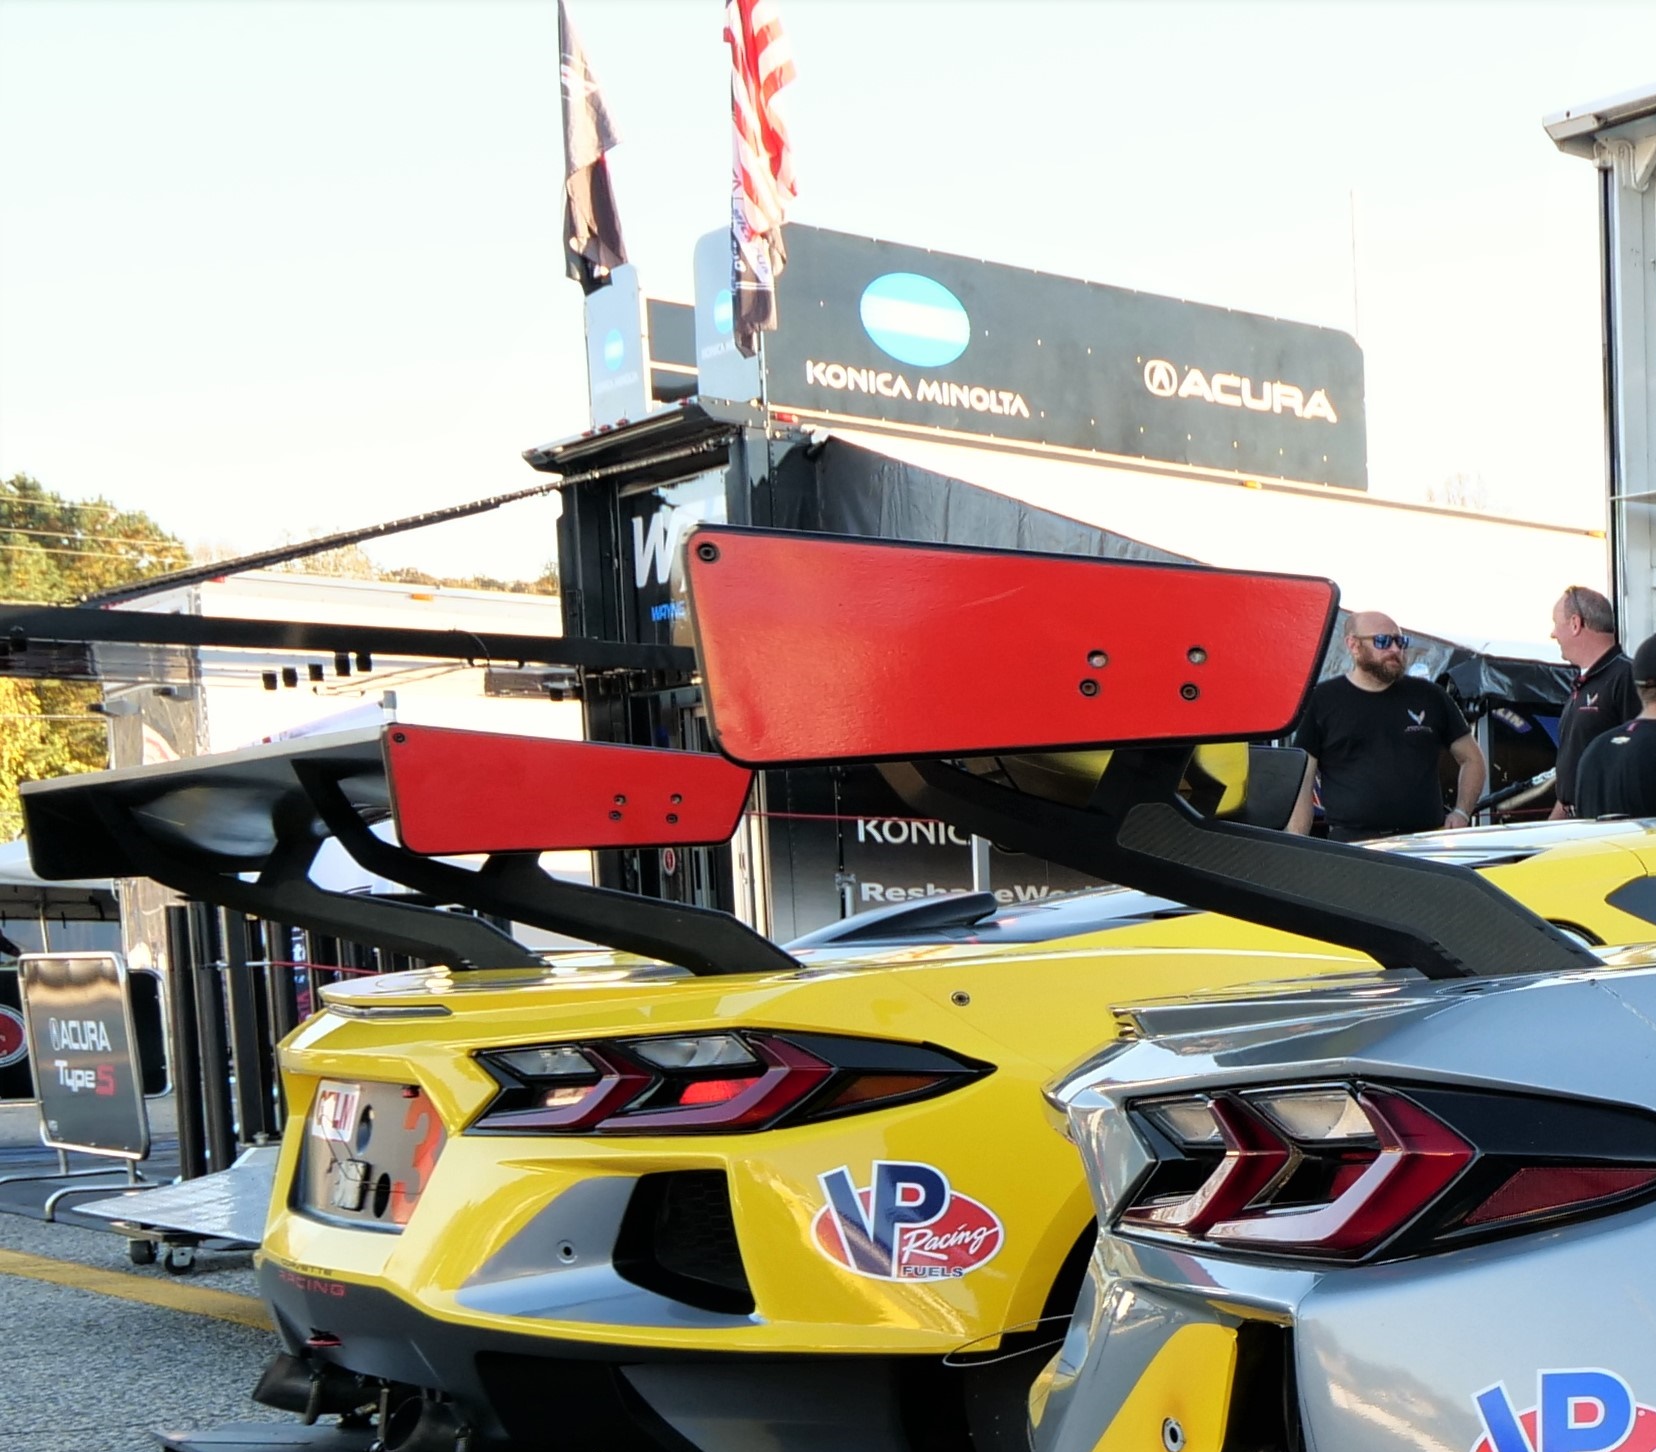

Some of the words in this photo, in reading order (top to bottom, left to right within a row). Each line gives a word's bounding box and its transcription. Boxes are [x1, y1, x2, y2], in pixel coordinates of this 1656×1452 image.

[806, 359, 913, 401] KONICA
[916, 378, 1030, 419] MINOLTA
[1177, 368, 1338, 424] ACURA
[857, 818, 992, 846] KONIC
[61, 1019, 112, 1052] ACURA
[54, 1059, 96, 1093] Type
[391, 1092, 443, 1224] 3
[817, 1159, 951, 1278] VP
[901, 1222, 999, 1264] Racing
[902, 1266, 964, 1278] FUELS
